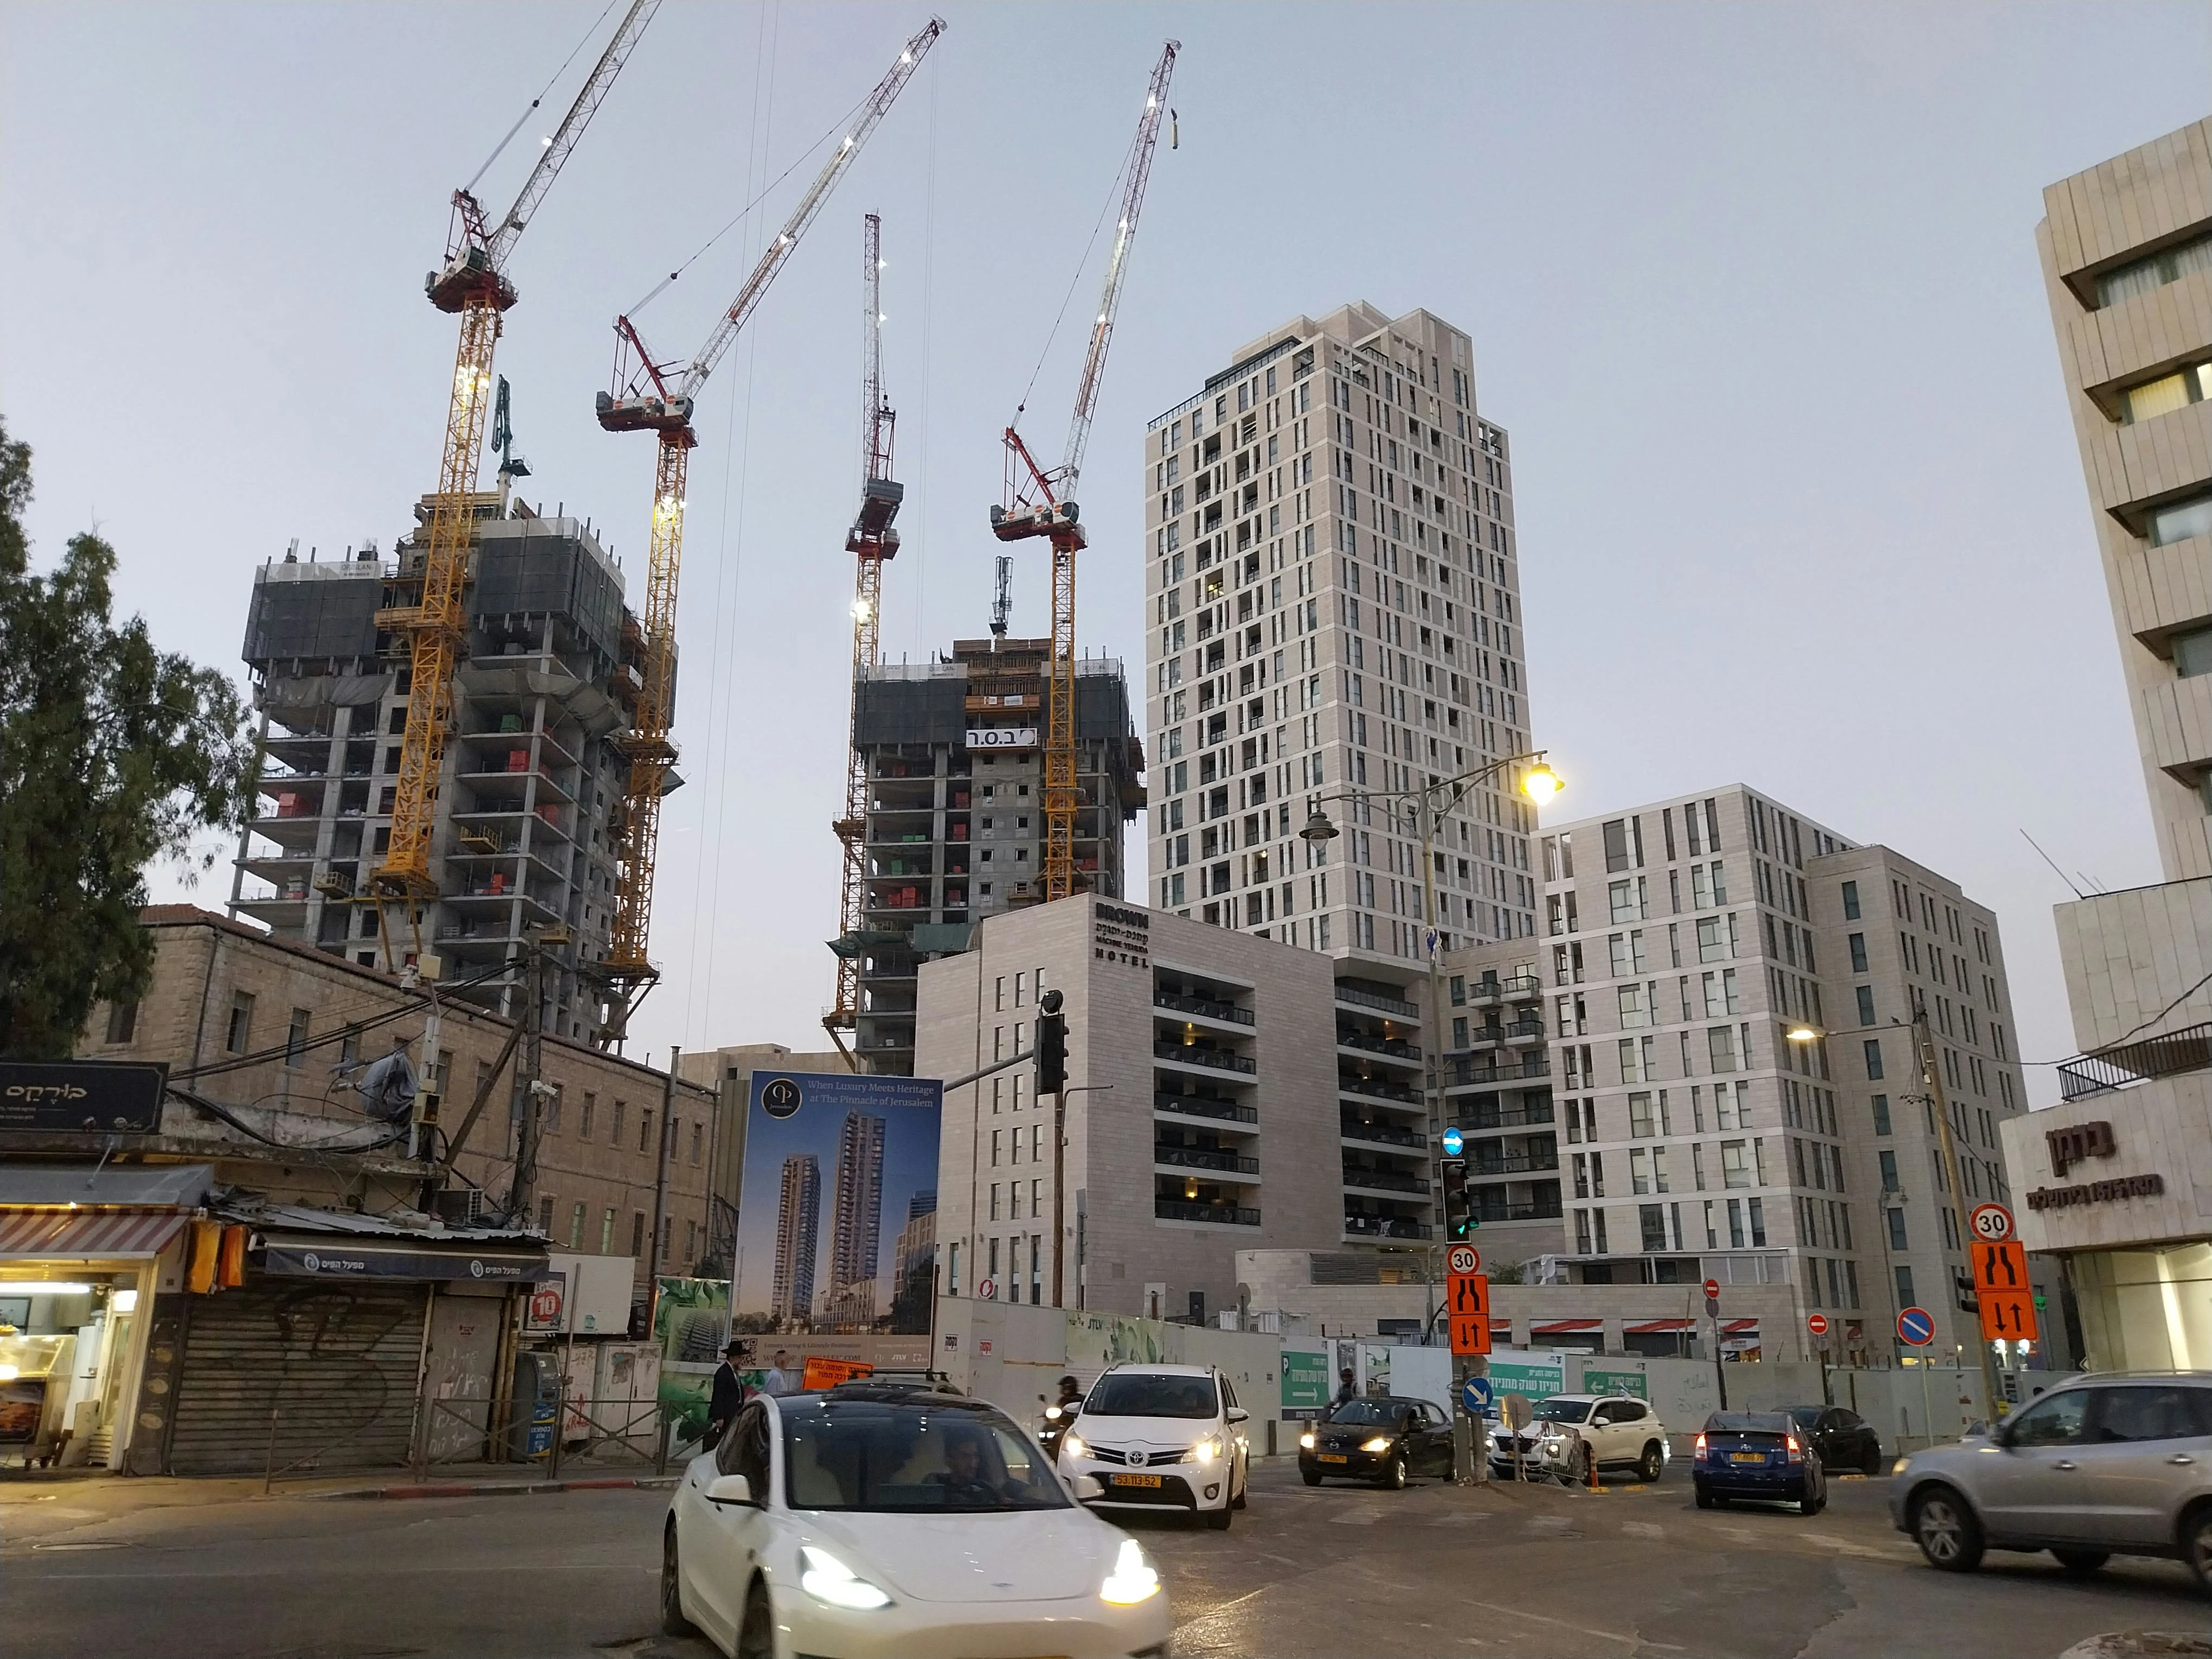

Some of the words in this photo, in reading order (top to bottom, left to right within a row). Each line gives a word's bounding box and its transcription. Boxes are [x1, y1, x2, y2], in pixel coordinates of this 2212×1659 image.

[1096, 902, 1148, 929] BROWN
[1096, 948, 1148, 968] HOTEL
[808, 1081, 833, 1089] When
[835, 1082, 867, 1092] Luxury
[869, 1083, 895, 1092] Meets
[897, 1085, 934, 1096] Heritage
[821, 1095, 838, 1103] The
[840, 1096, 877, 1105] Pinnacle
[879, 1096, 889, 1105] of
[890, 1097, 933, 1108] Jerusalem
[1979, 1214, 2004, 1232] 30
[342, 1261, 364, 1269] מפעל
[1454, 1253, 1473, 1268] 30
[502, 1266, 521, 1275] מפעל
[537, 1296, 556, 1315] 10
[1088, 1319, 1103, 1330] JTLV
[1519, 1380, 1537, 1391] שוק
[1539, 1381, 1559, 1392] חניון
